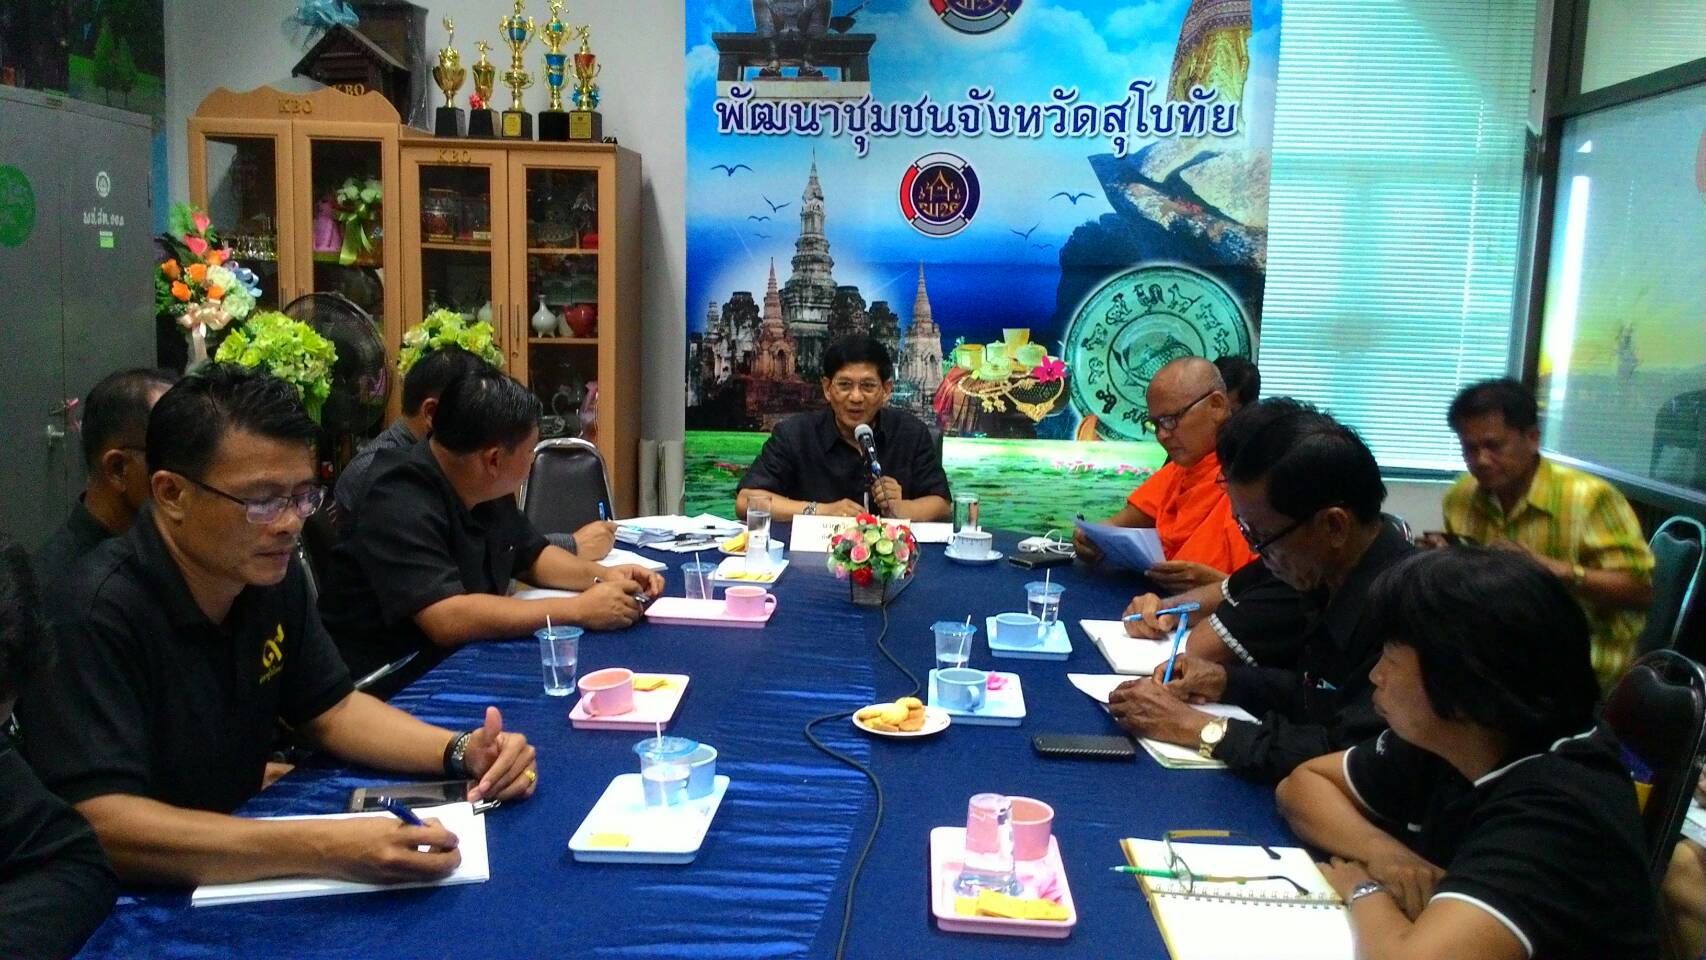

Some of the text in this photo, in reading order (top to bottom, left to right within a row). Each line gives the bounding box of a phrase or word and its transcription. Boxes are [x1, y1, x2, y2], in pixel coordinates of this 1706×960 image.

[278, 97, 313, 114] KBO
[714, 78, 1237, 156] พัฒนาชุมชนจังหวัดสุโขทัย
[436, 148, 472, 163] KBO
